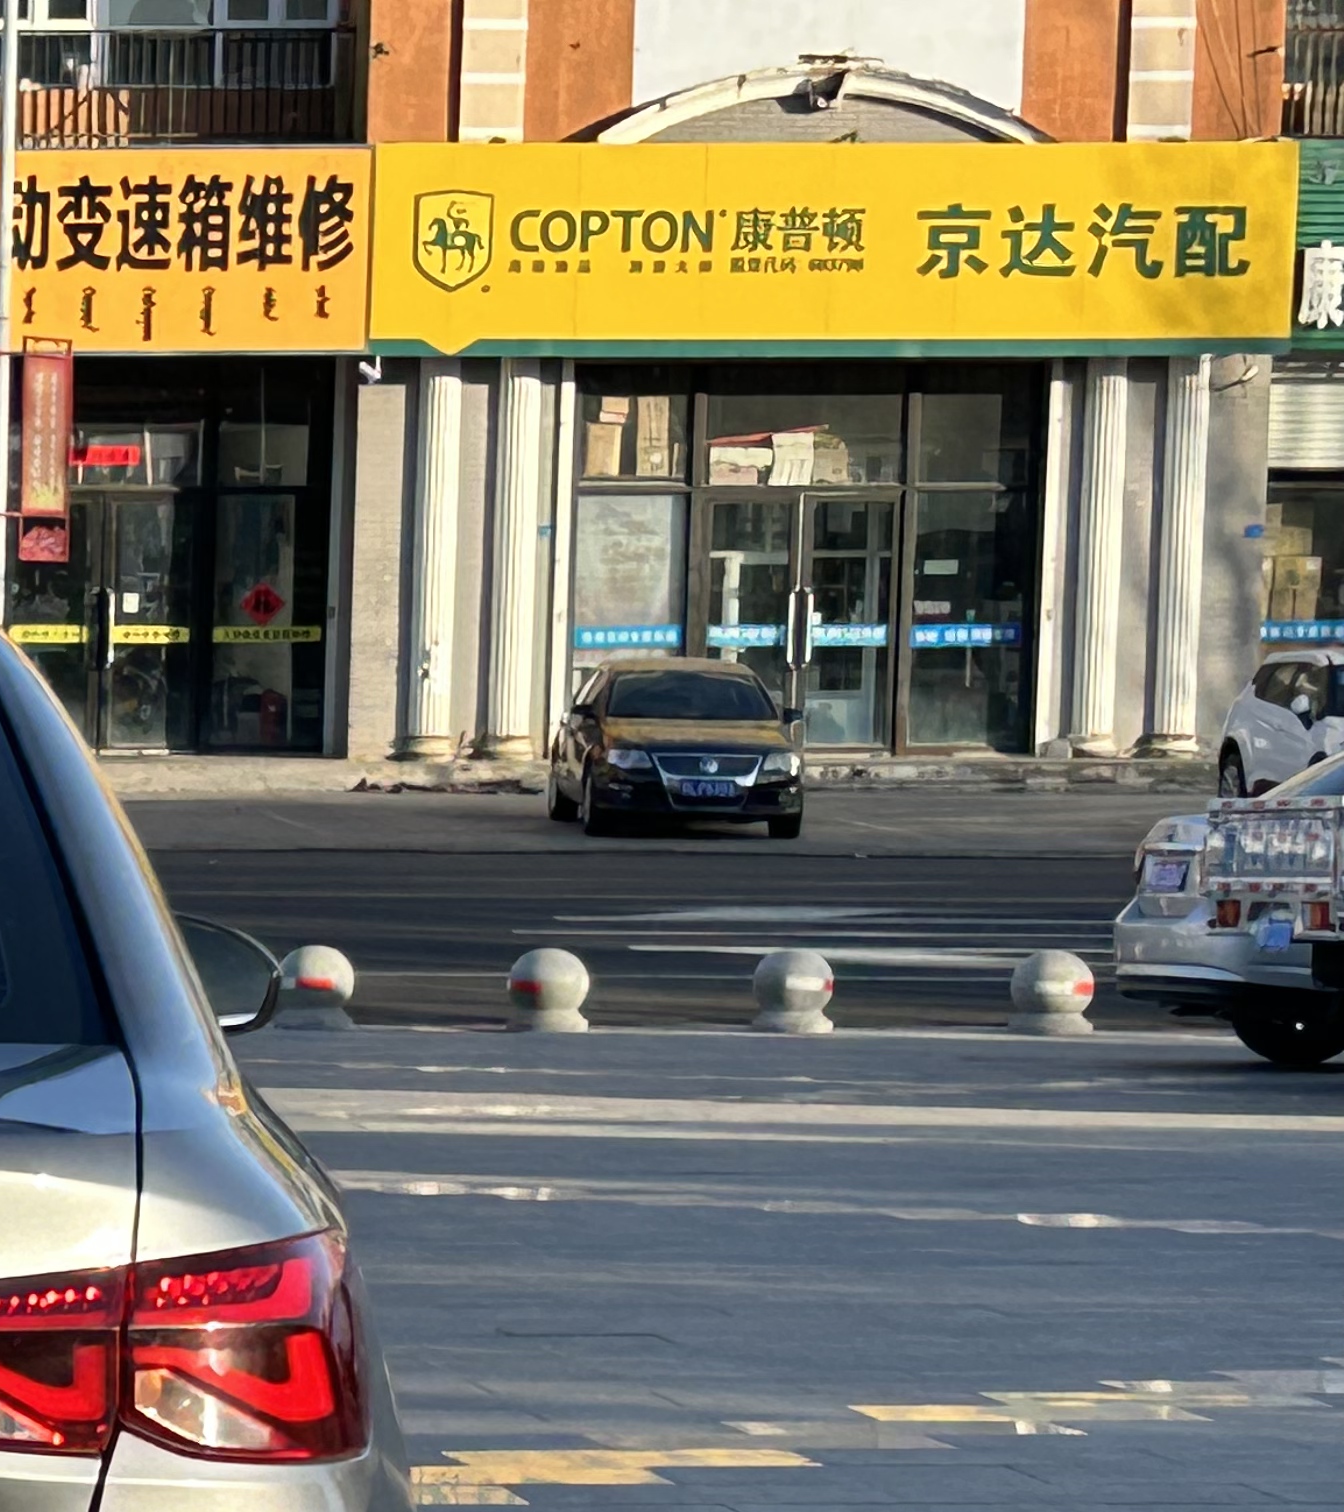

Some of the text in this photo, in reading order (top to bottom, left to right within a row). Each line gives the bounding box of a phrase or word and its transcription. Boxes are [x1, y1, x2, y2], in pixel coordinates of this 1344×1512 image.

[510, 209, 715, 253] COPTON
[730, 207, 866, 253] 康普顿
[915, 202, 1251, 280] 京达汽配
